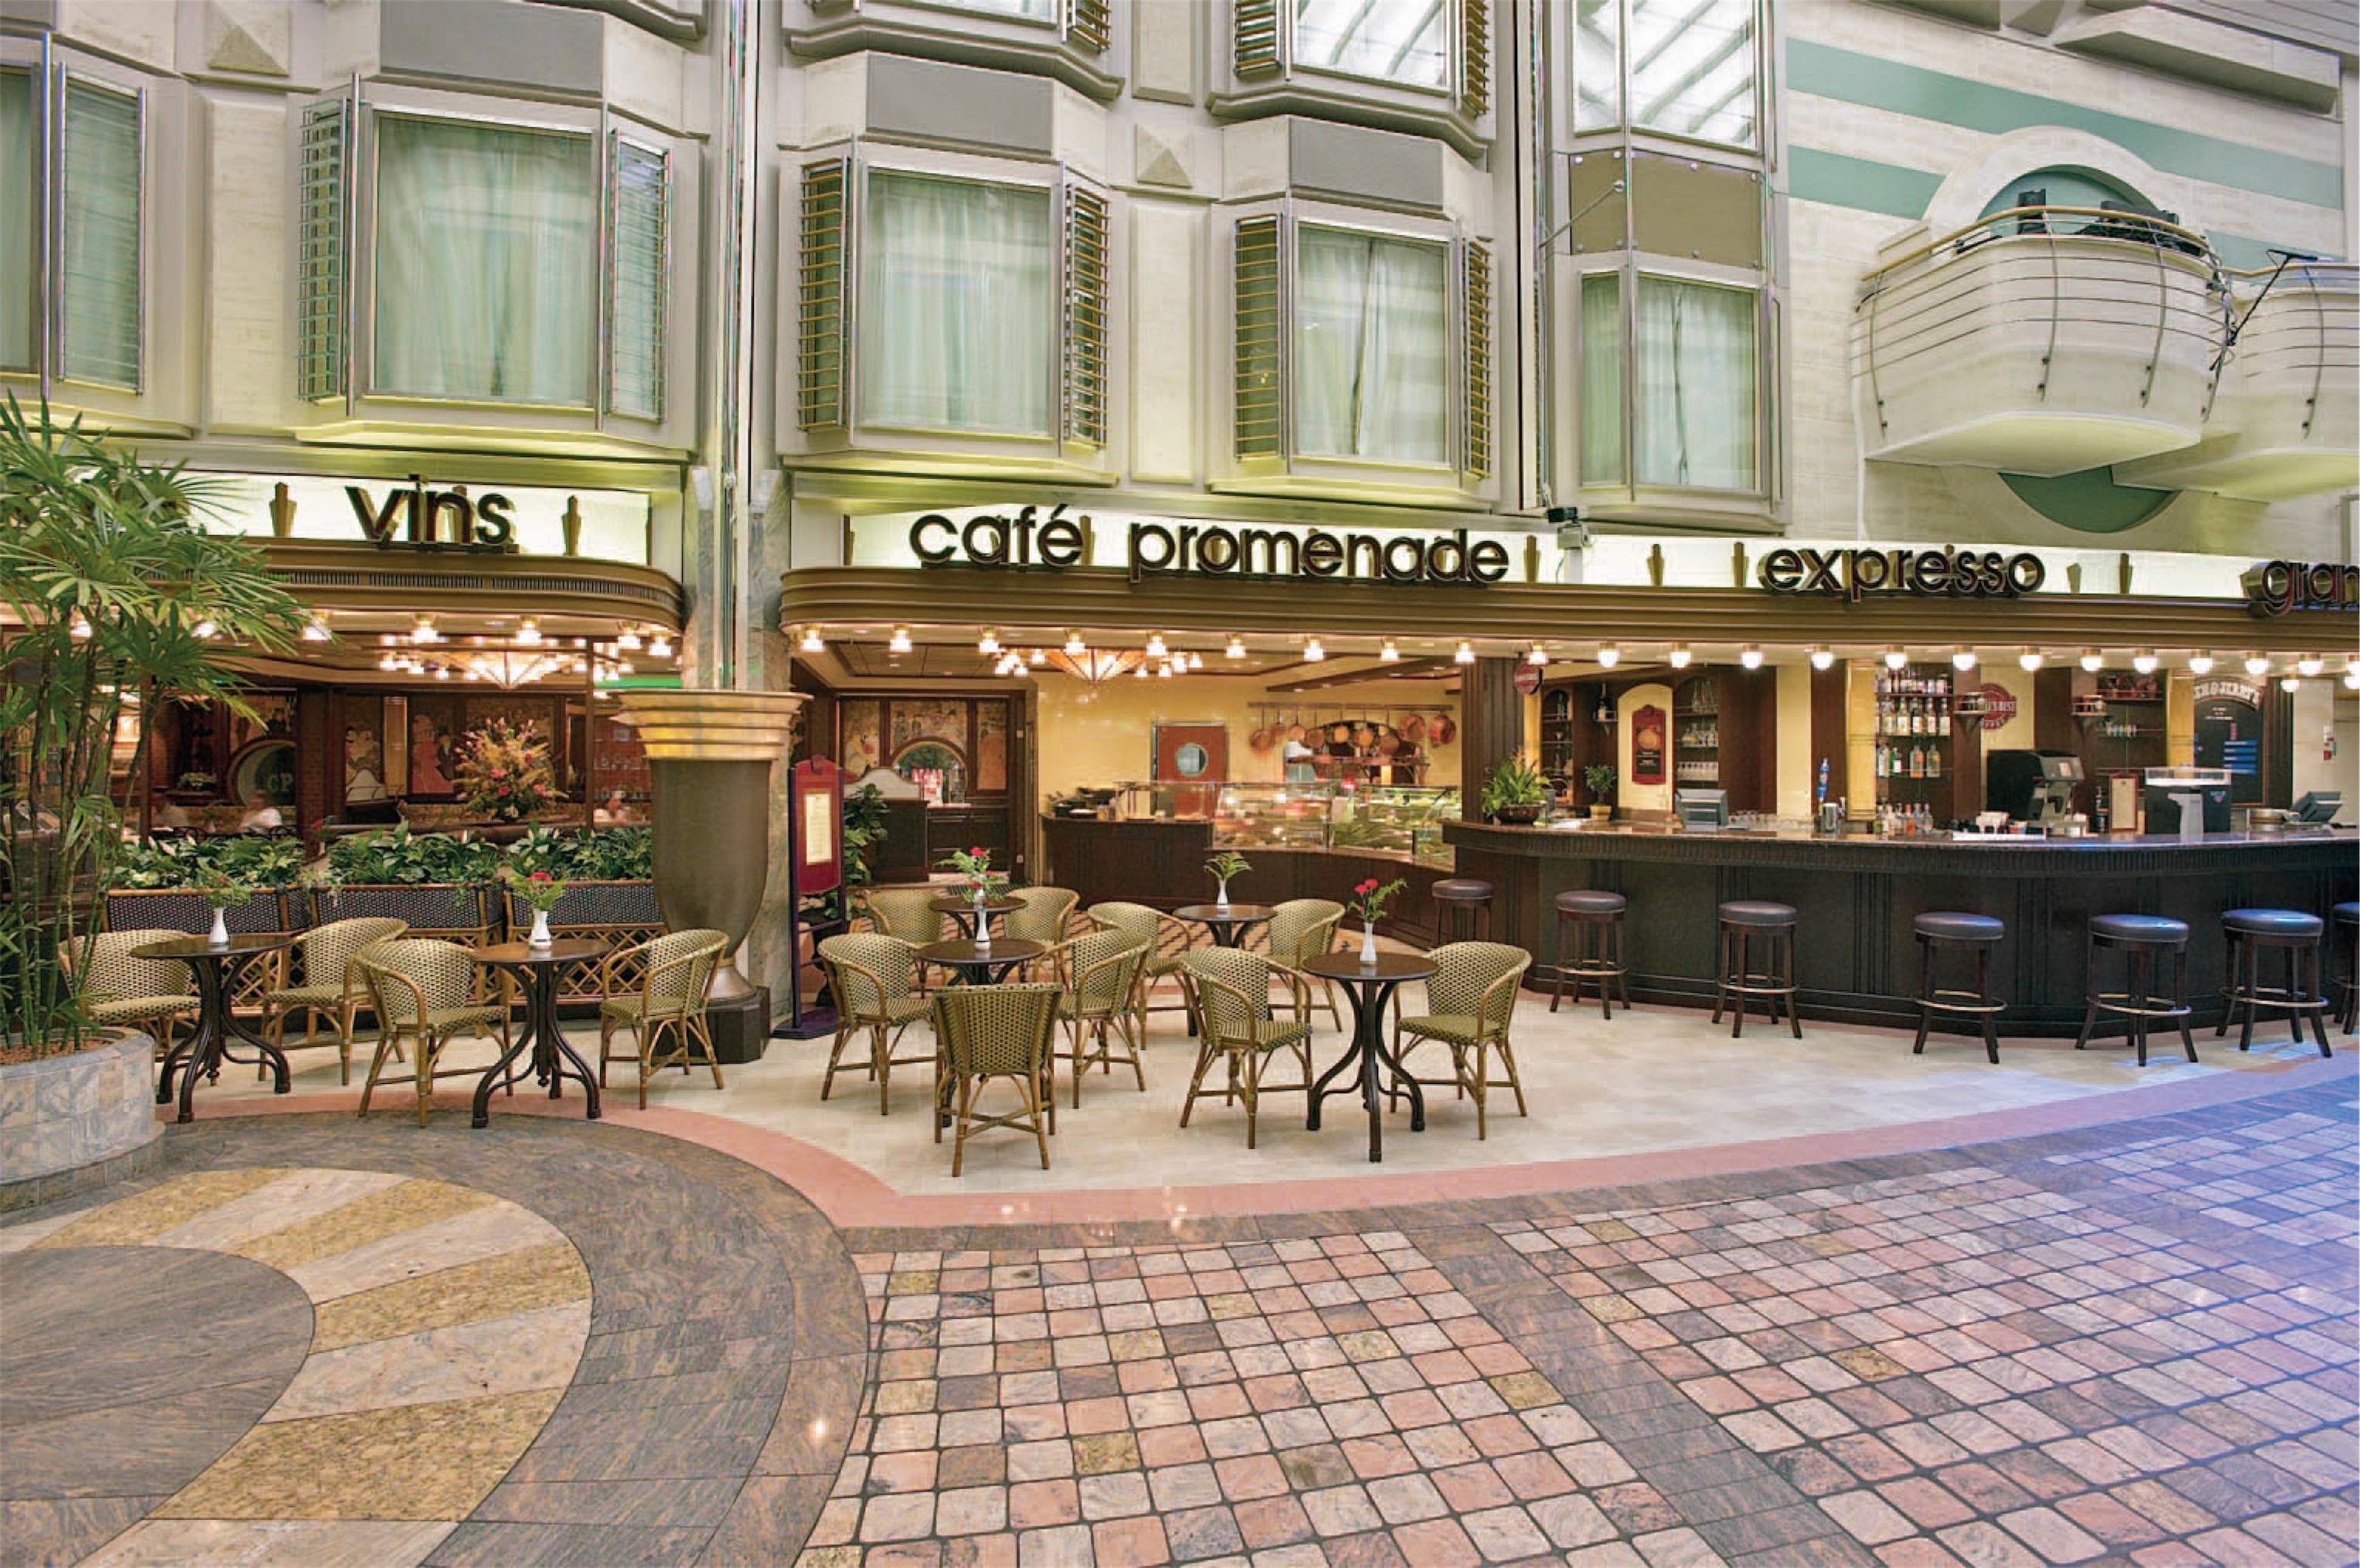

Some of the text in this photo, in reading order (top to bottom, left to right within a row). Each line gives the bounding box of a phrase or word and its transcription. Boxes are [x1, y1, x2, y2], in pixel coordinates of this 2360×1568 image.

[345, 474, 513, 544] vins
[909, 503, 1509, 583] café promenade
[1760, 547, 2045, 603] expresso
